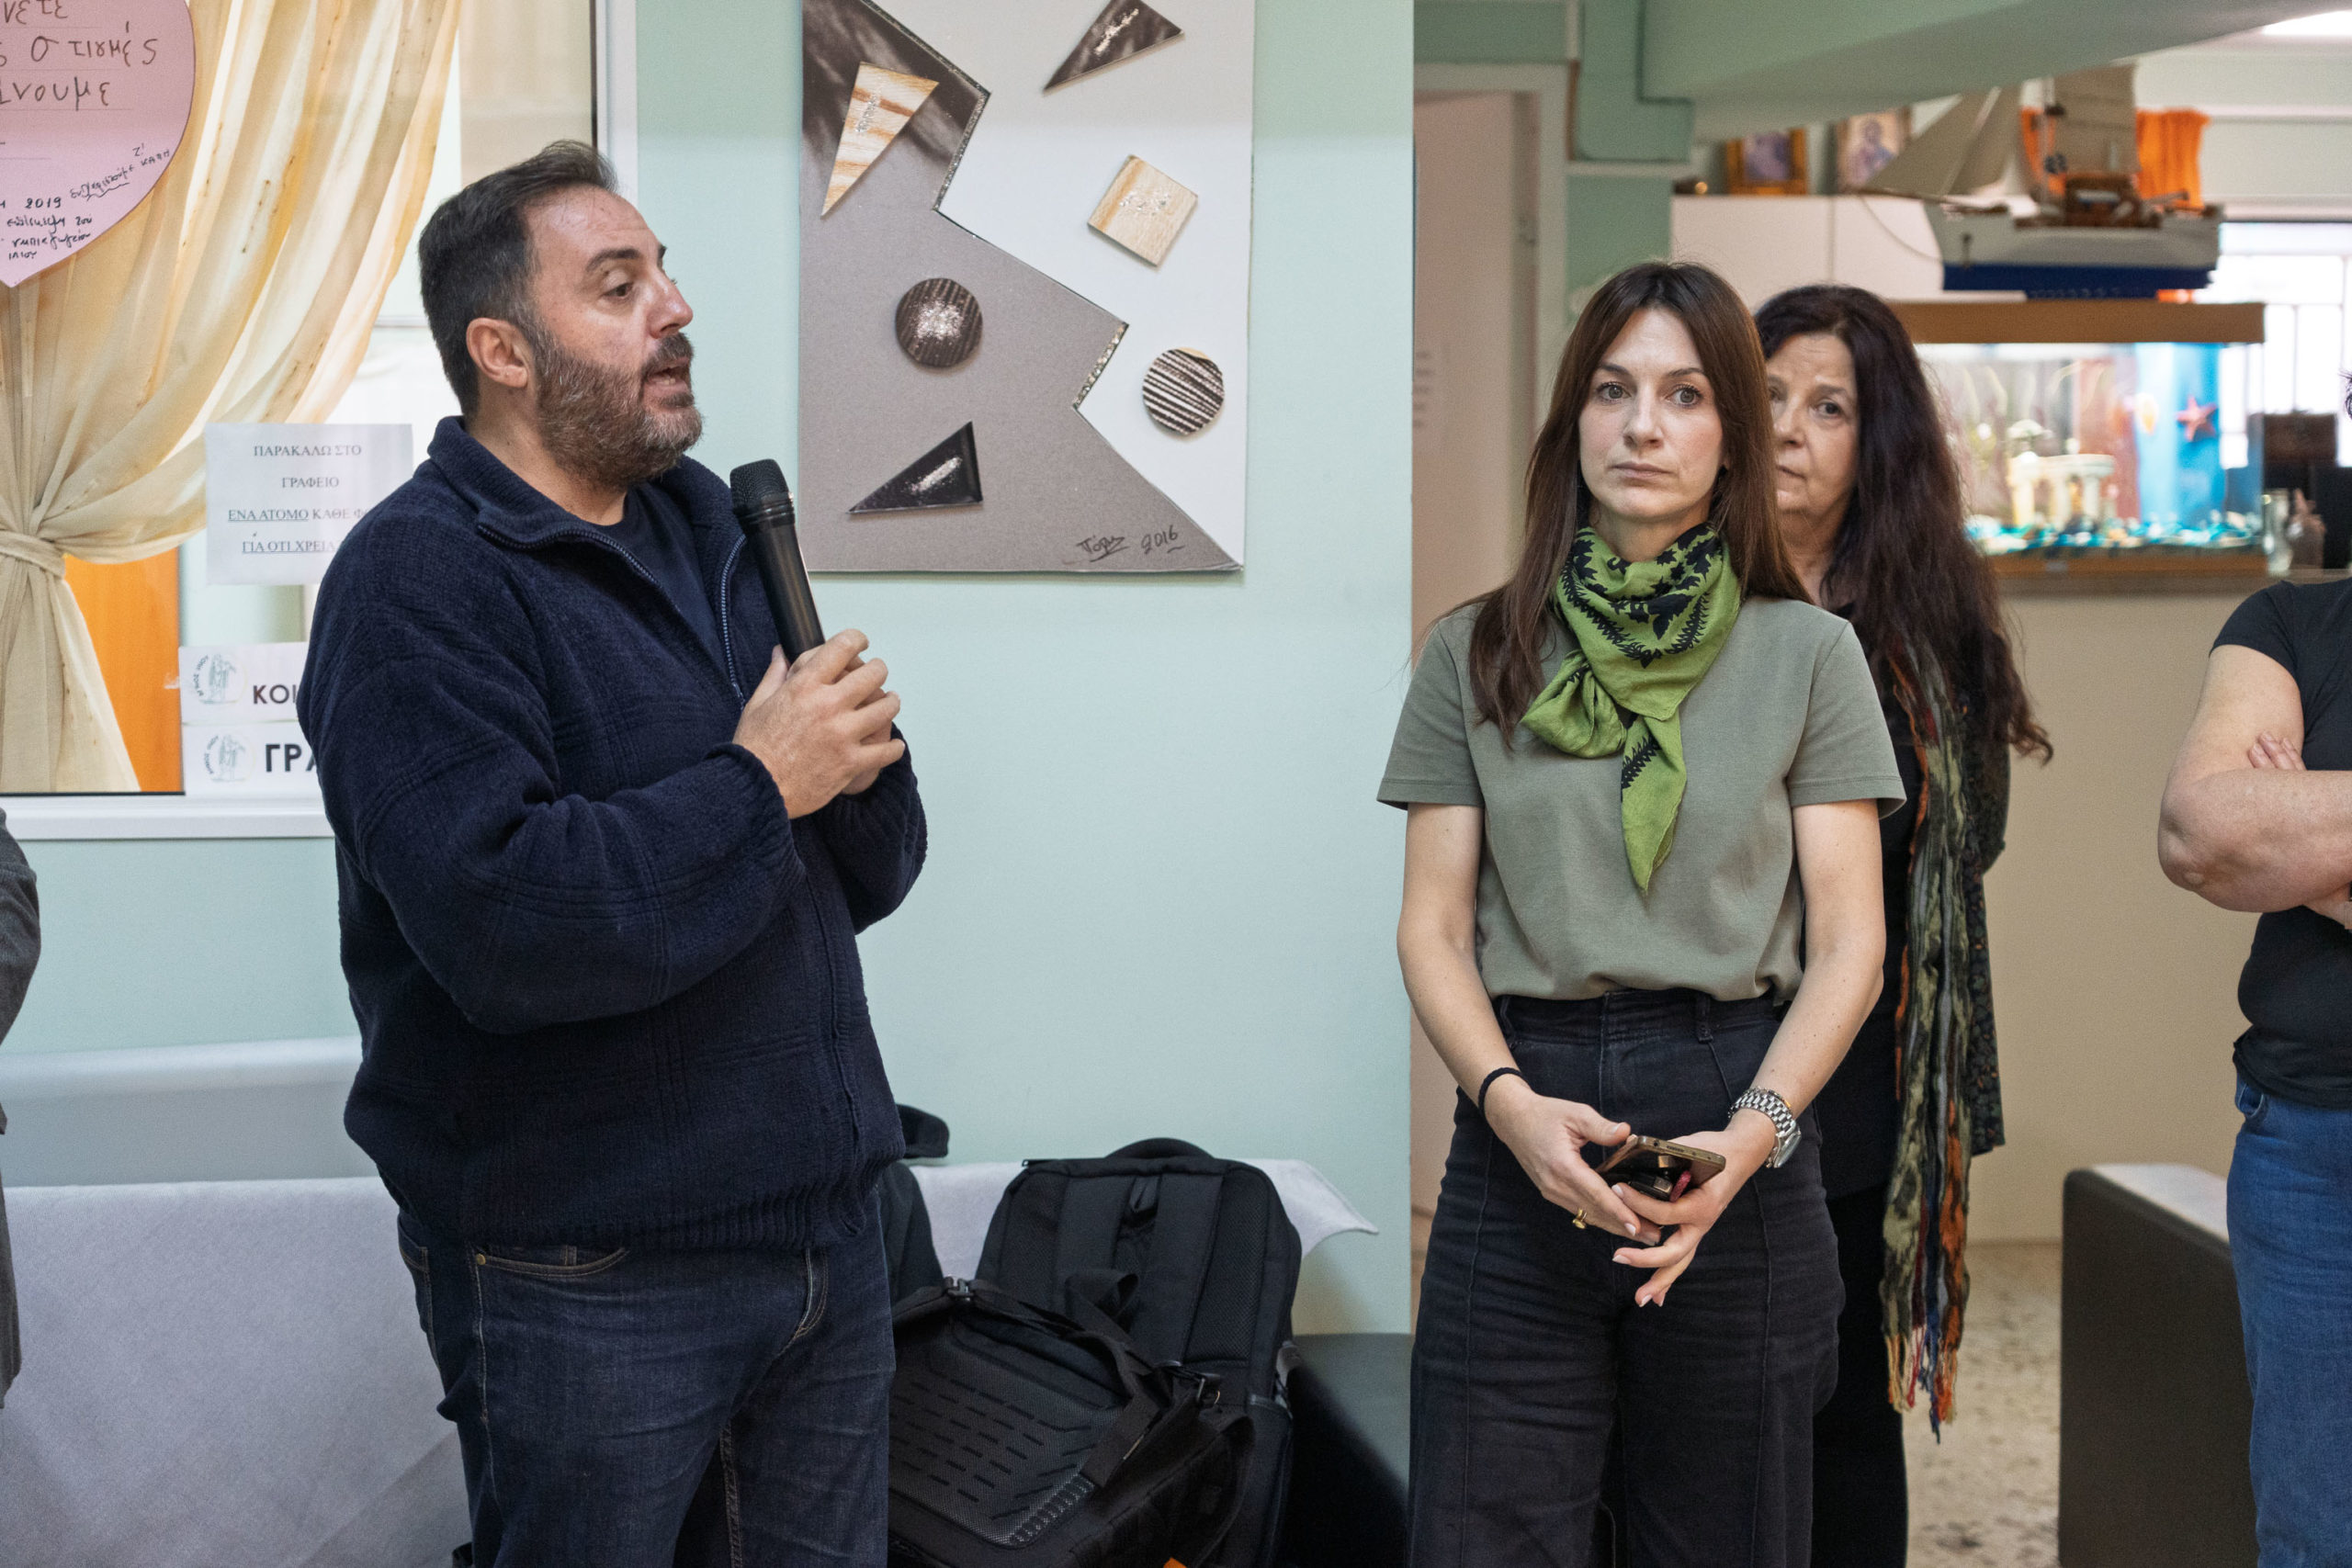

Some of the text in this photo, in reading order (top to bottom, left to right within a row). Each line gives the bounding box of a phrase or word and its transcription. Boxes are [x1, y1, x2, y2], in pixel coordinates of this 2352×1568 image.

[25, 196, 62, 209] 2019
[253, 445, 362, 457] ΠΑΡΑΚΑΛΩ ΣΤΟ
[281, 477, 340, 488] ΓΡΑΦΕΙΟ
[228, 509, 255, 521] ΕΝΑ
[259, 509, 309, 521] ΑΤΟΜΟ
[312, 508, 352, 520] ΚΑΘΕ
[1140, 525, 1179, 555] 2016
[267, 541, 291, 553] ΟΤΙ
